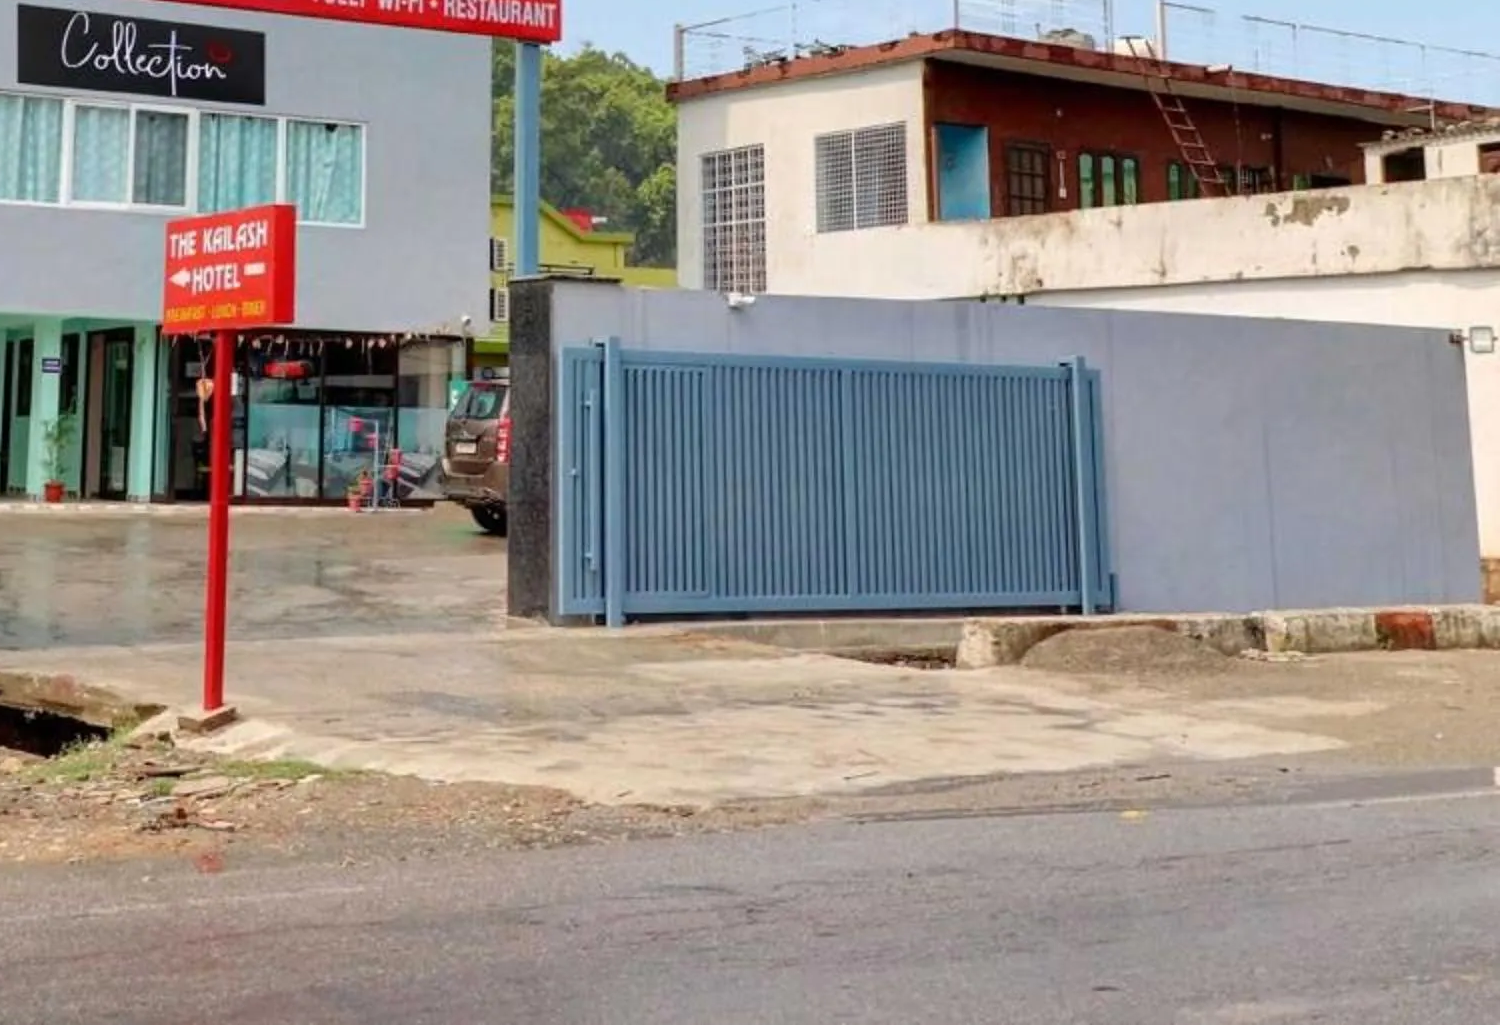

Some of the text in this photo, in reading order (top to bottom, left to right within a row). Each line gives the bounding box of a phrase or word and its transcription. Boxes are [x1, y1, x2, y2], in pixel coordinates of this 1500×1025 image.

[61, 11, 227, 96] Collection
[170, 219, 268, 259] THE KAILASH
[192, 263, 241, 295] HOTEL
